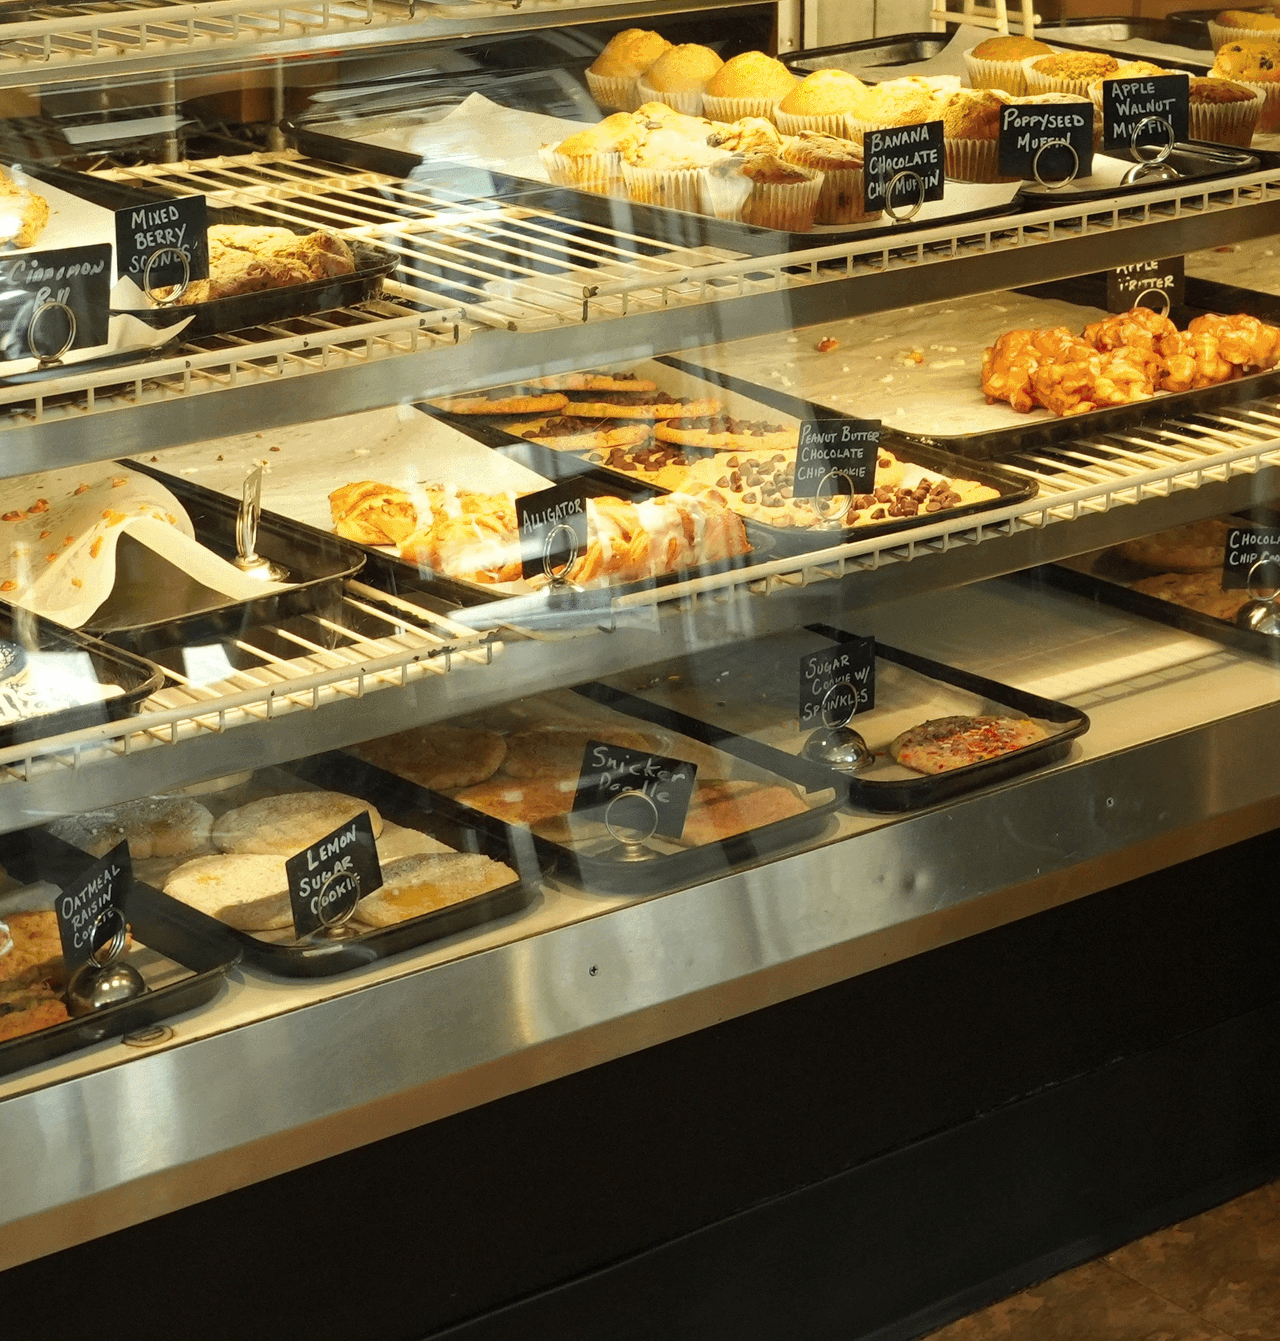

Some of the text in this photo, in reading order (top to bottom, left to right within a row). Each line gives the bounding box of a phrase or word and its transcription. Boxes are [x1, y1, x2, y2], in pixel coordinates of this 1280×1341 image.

[1111, 81, 1156, 100] APPLE
[1002, 107, 1085, 131] POPPYSEED
[1116, 98, 1176, 117] WALNUT
[870, 125, 930, 154] BANANA
[869, 149, 939, 176] CHOCOLATE
[131, 205, 180, 230] MIXED
[134, 223, 187, 250] BERRY
[9, 259, 105, 286] Cinnamon
[800, 424, 880, 445] PEANUT BUTTER
[801, 447, 864, 463] CHOCOLATE
[797, 467, 825, 480] CHIP
[522, 498, 583, 535] ALLIGATOR
[1229, 551, 1259, 570] CHIP
[805, 654, 850, 680] SUGAR
[854, 666, 870, 684] W/
[592, 746, 686, 783] Snicker
[599, 772, 671, 804] Doodle
[306, 823, 357, 871] LEMON
[299, 855, 353, 897] SUGAR
[62, 864, 121, 919] OATMEAL
[72, 884, 112, 931] RAISIN
